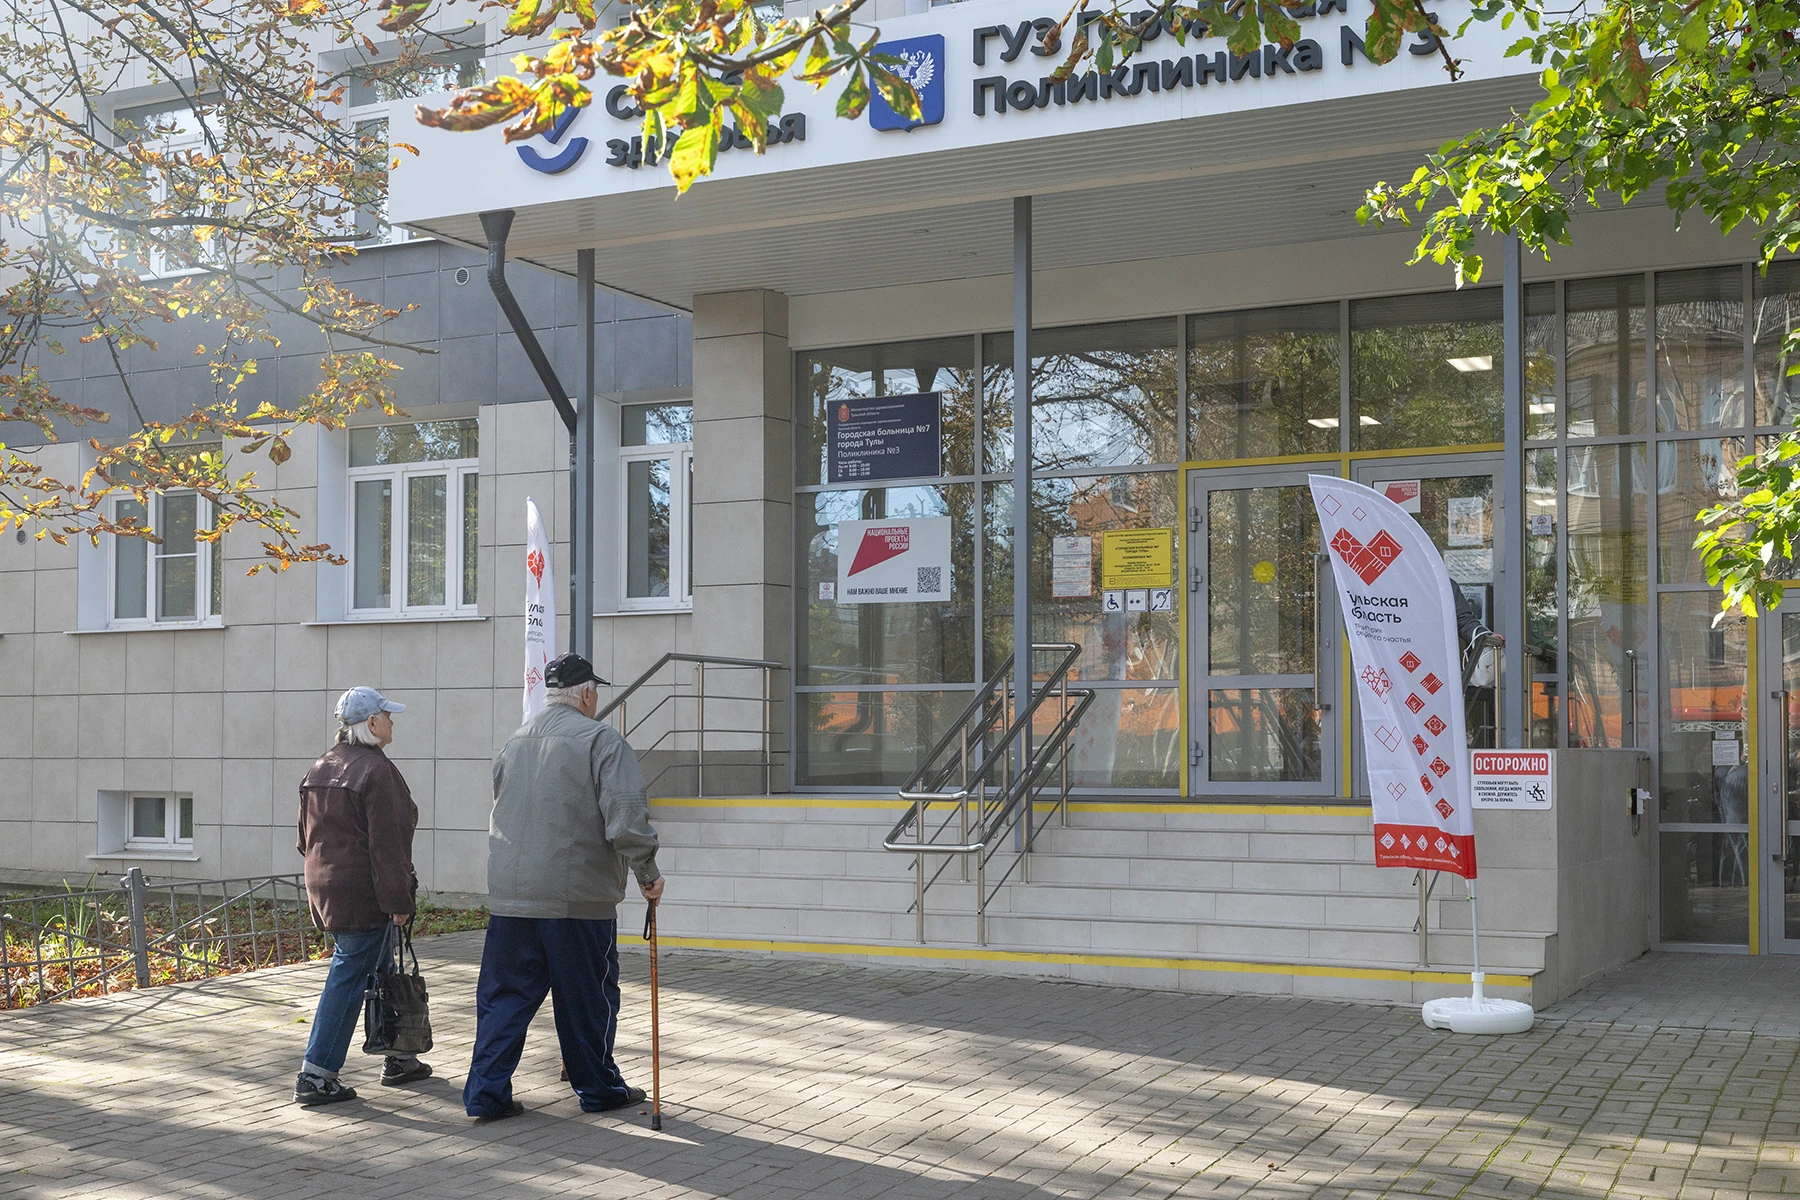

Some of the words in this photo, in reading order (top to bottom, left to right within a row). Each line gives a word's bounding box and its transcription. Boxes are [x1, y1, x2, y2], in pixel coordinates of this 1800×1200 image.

[973, 17, 1062, 66] ГУЗ
[972, 38, 1323, 116] Поликлиника
[838, 430, 876, 440] Городская
[877, 427, 914, 436] больница
[916, 424, 930, 433] №7
[838, 440, 863, 449] города
[865, 438, 884, 447] Тулы
[838, 448, 885, 458] Поликлиника
[886, 446, 900, 454] №3
[867, 528, 908, 536] НАЦИОНАЛЬНЫЕ
[1346, 590, 1408, 607] ульская
[1475, 757, 1547, 771] ОСТОРОЖНО
